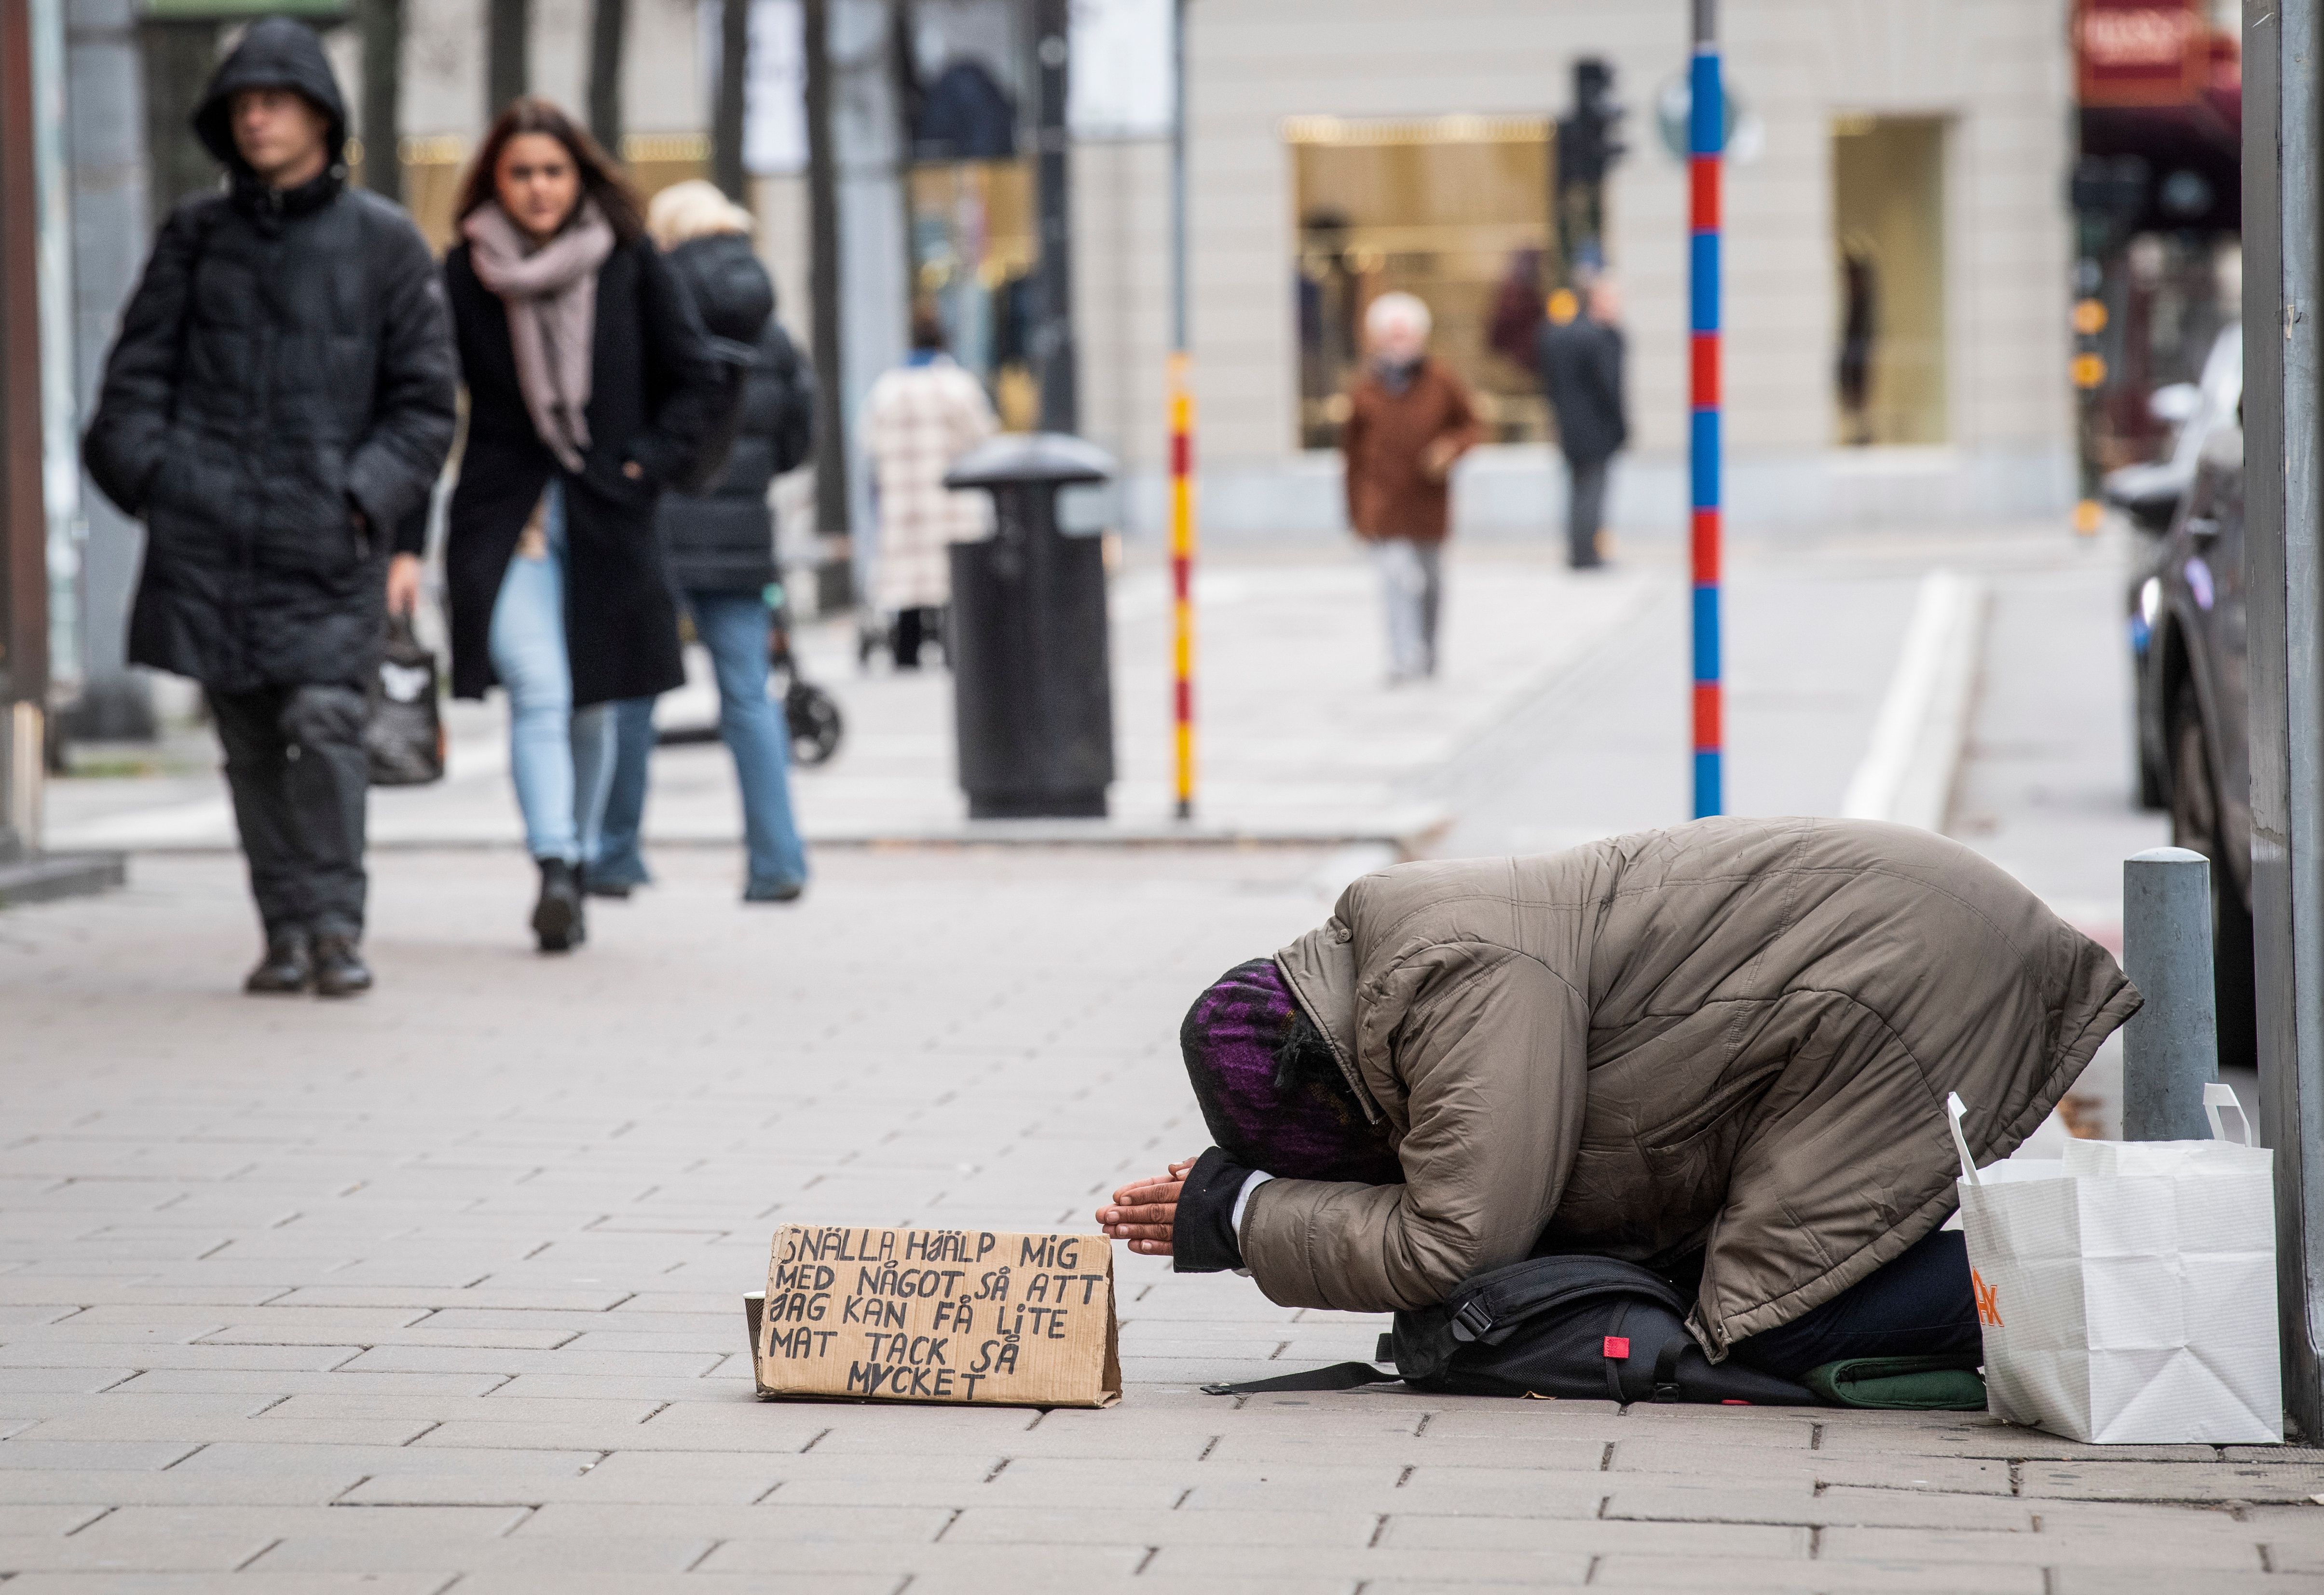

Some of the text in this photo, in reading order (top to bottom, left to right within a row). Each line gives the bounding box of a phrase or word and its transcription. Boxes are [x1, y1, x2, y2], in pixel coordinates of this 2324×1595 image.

[905, 1230, 996, 1263] HJÄLP
[775, 1260, 1104, 1305] MED NÅGOT SÅ ATT
[1972, 1266, 2005, 1327] AX
[769, 1287, 831, 1322] JAG
[842, 1295, 907, 1329] KAN
[932, 1295, 973, 1334] FÅ
[769, 1326, 1021, 1375] MAT TACK SÅ
[847, 1361, 986, 1401] MYCKET
